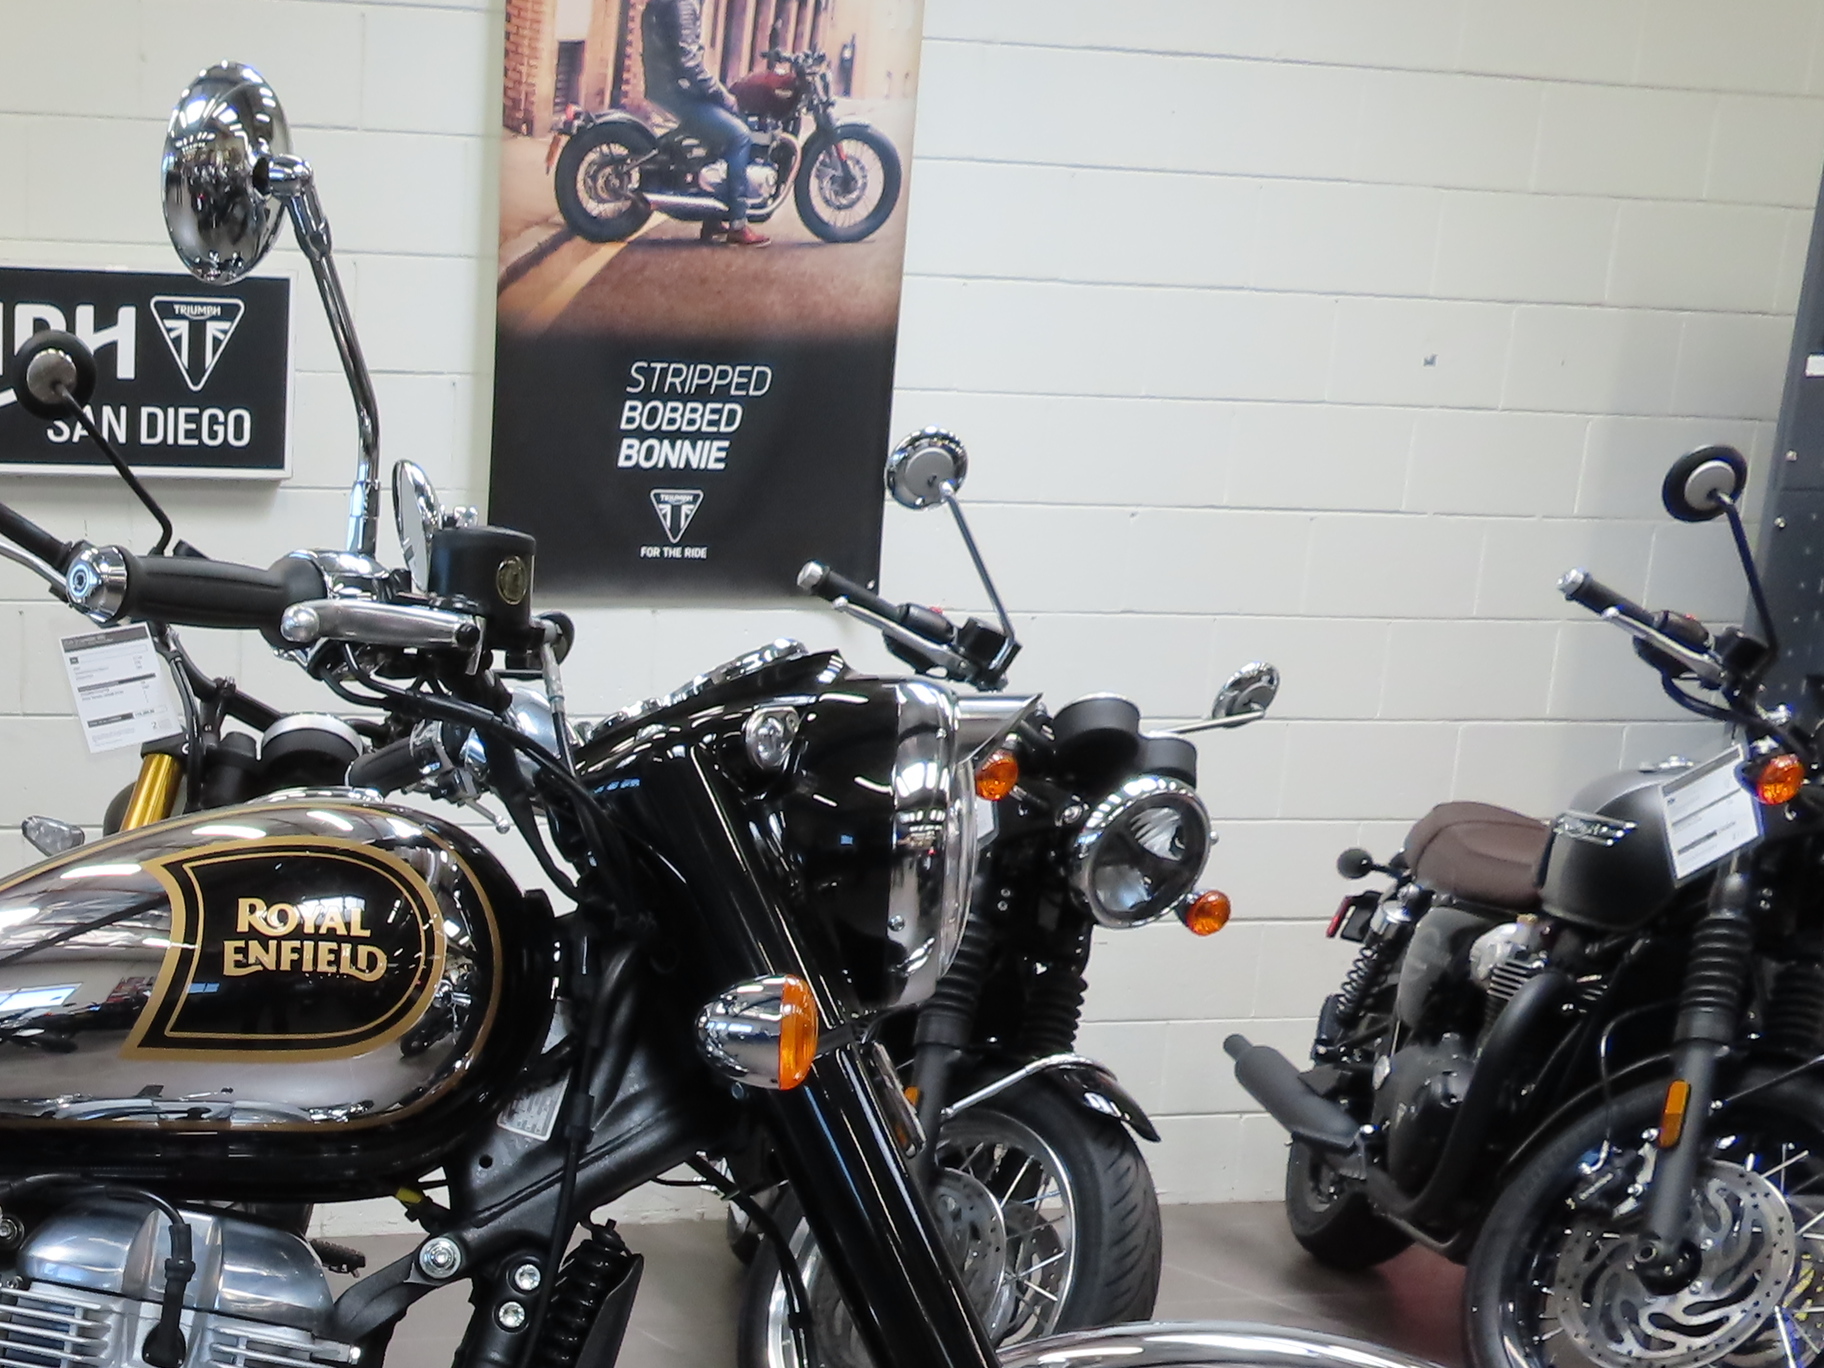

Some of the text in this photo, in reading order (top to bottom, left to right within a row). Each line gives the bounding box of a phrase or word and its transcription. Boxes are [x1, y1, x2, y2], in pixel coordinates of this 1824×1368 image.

[173, 303, 222, 319] TRIUMPH
[626, 361, 773, 397] STRIPPED
[46, 404, 252, 447] SAN DIEGO
[620, 399, 744, 433] BOBBED
[617, 437, 731, 470] BONNIE
[640, 546, 707, 559] FOR THE RIDE
[236, 897, 372, 937] ROYAL
[223, 939, 388, 982] ENFIELD
